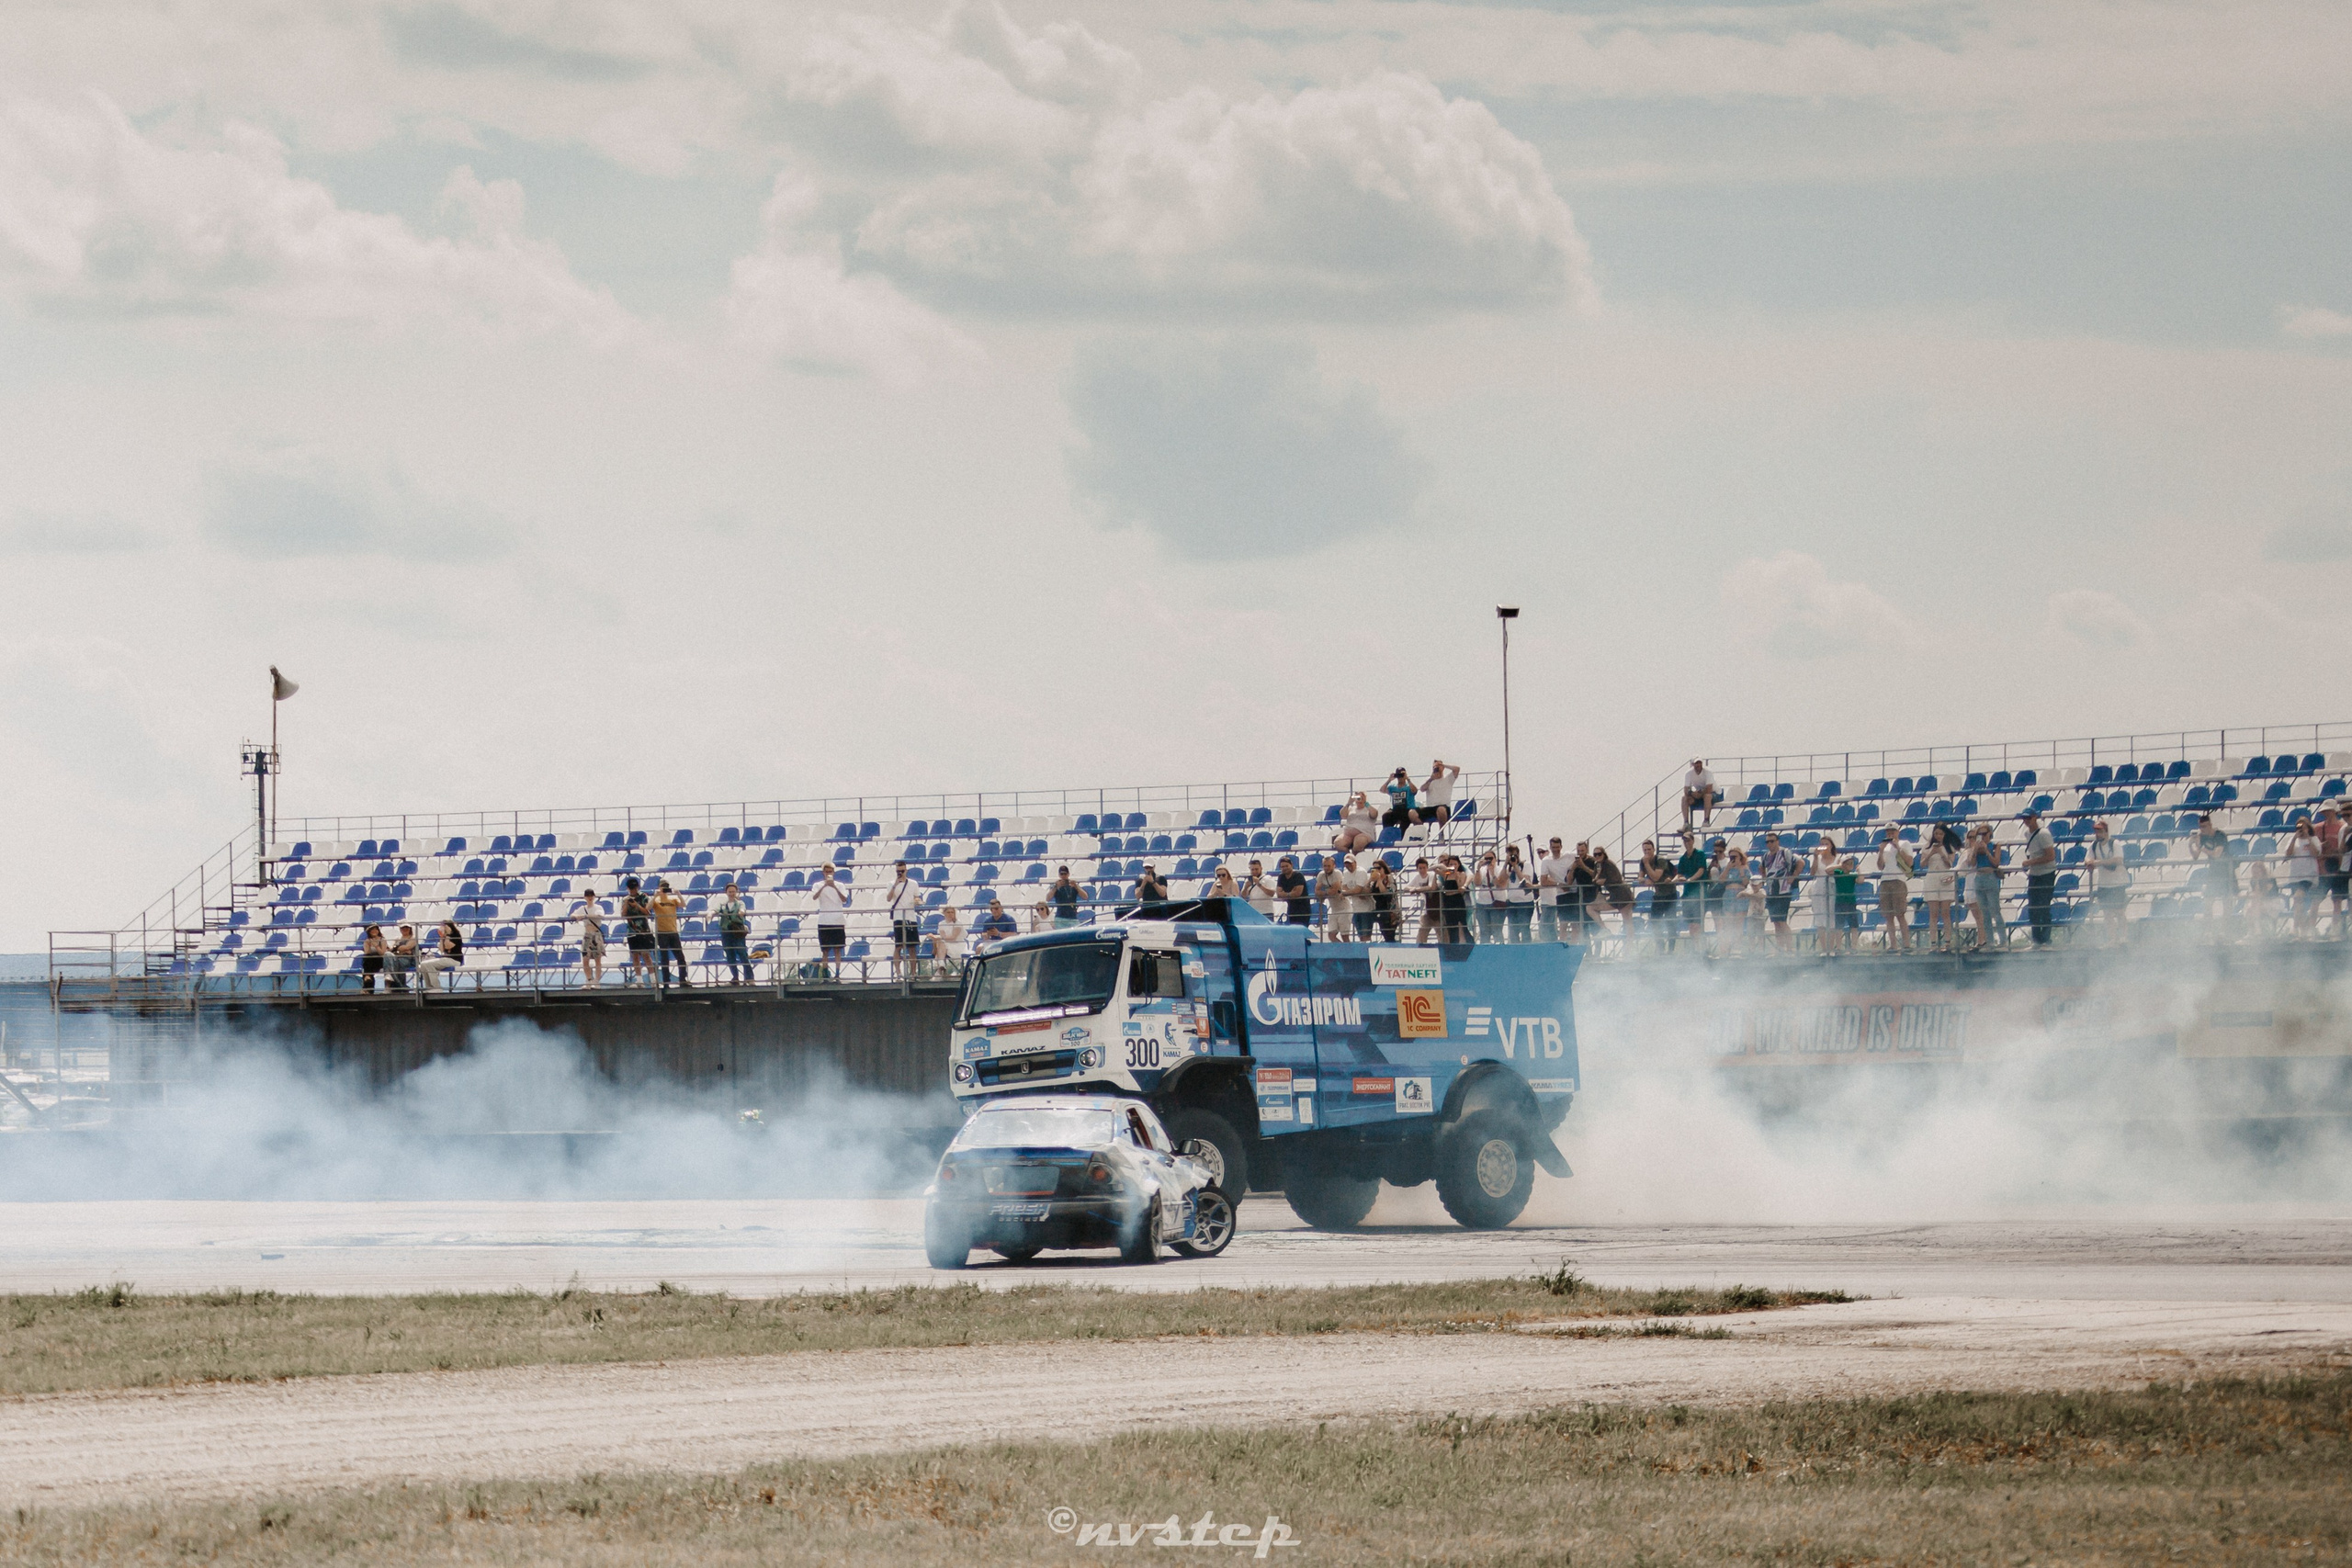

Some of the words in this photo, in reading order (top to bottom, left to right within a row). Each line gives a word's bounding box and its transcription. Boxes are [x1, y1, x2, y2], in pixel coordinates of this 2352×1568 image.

[1385, 969, 1437, 978] TATNEFT
[1283, 997, 1362, 1026] ГАЗПРОМ
[1797, 1005, 1862, 1054] NEED
[1865, 1004, 1895, 1052] IS
[1897, 1002, 1973, 1050] DRIFT
[1495, 1017, 1564, 1059] VTB
[965, 1045, 989, 1054] KAMAZ
[1001, 1045, 1046, 1055] KAMAZ
[1125, 1038, 1159, 1067] 300
[1163, 1050, 1182, 1058] KAMAZ
